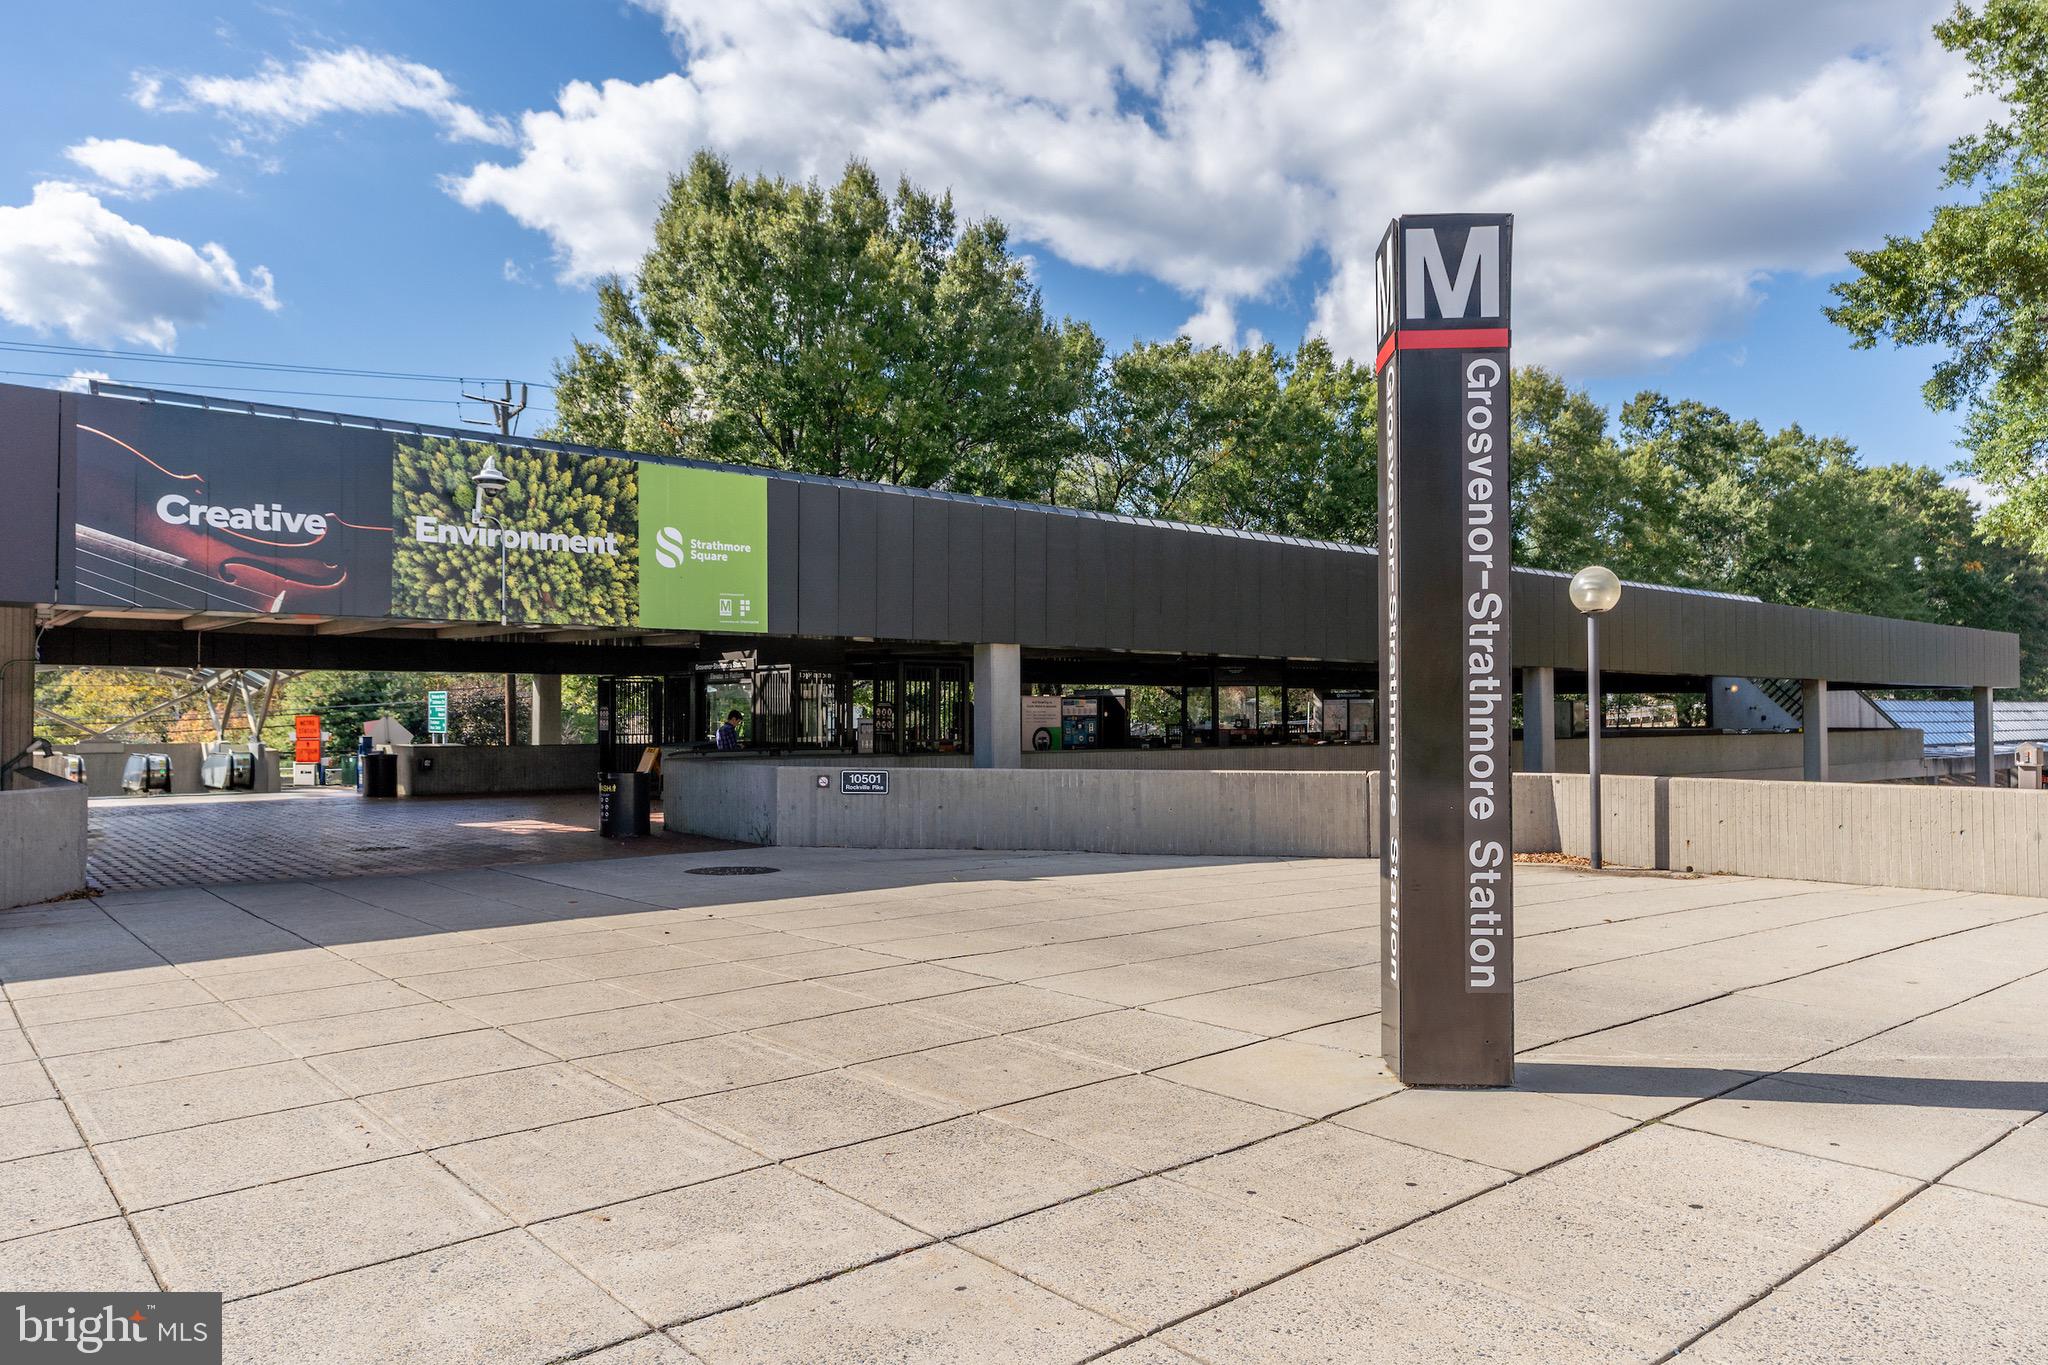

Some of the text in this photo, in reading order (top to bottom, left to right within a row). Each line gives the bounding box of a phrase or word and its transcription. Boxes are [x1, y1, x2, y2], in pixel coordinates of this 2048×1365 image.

[1406, 225, 1499, 319] M
[156, 494, 327, 535] Creative
[415, 515, 620, 556] Environment
[690, 539, 752, 553] Strathmore
[690, 550, 728, 562] Square
[849, 774, 881, 784] 10501
[1390, 836, 1399, 981] Station
[1469, 840, 1504, 987] Station
